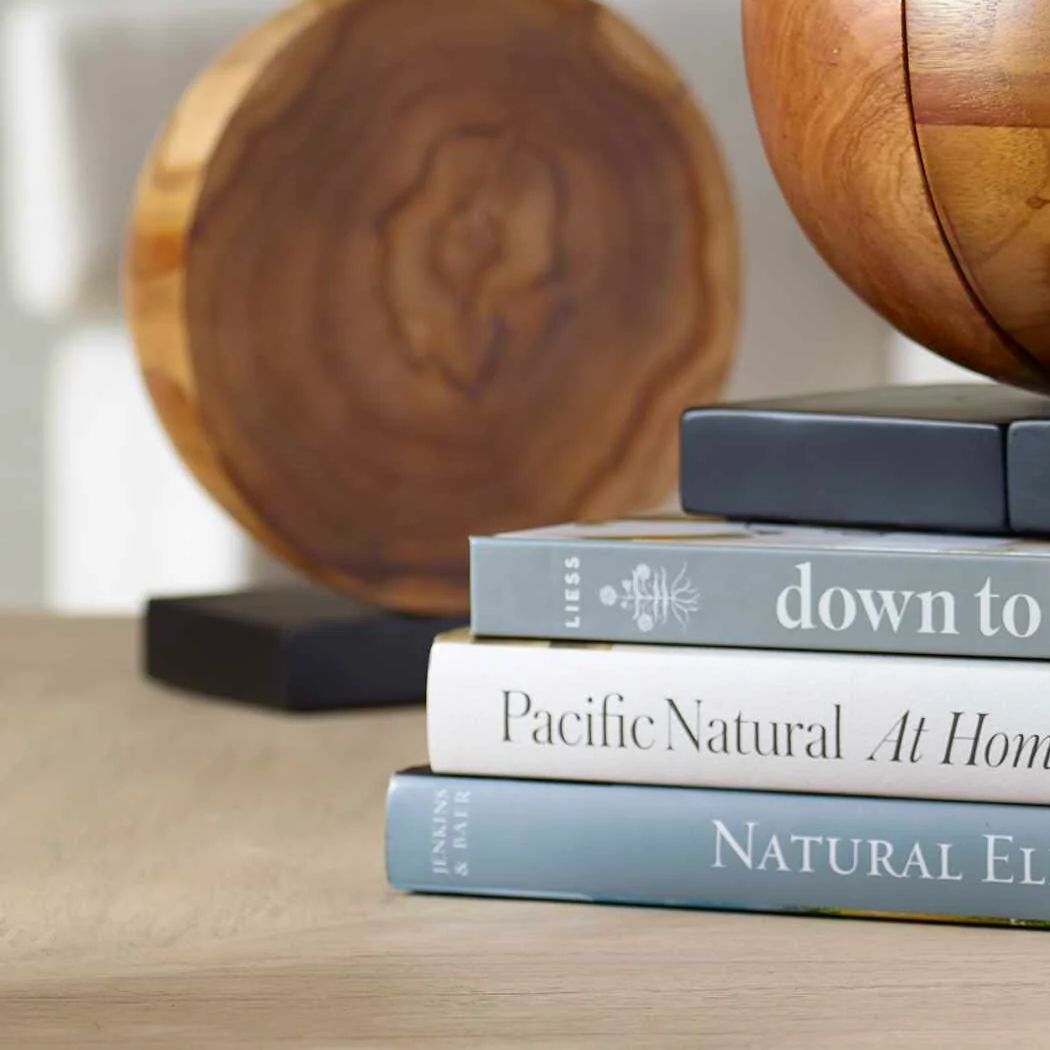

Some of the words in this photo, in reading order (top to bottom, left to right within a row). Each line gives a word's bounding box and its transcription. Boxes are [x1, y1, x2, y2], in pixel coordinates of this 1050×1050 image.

[564, 556, 581, 629] LIESS
[776, 561, 960, 634] down
[974, 576, 1042, 638] to
[500, 688, 655, 751] Pacific
[665, 697, 845, 761] Natural
[866, 708, 930, 765] At
[431, 788, 449, 876] JENKINS
[454, 860, 469, 878] &
[711, 819, 964, 882] NATURAL
